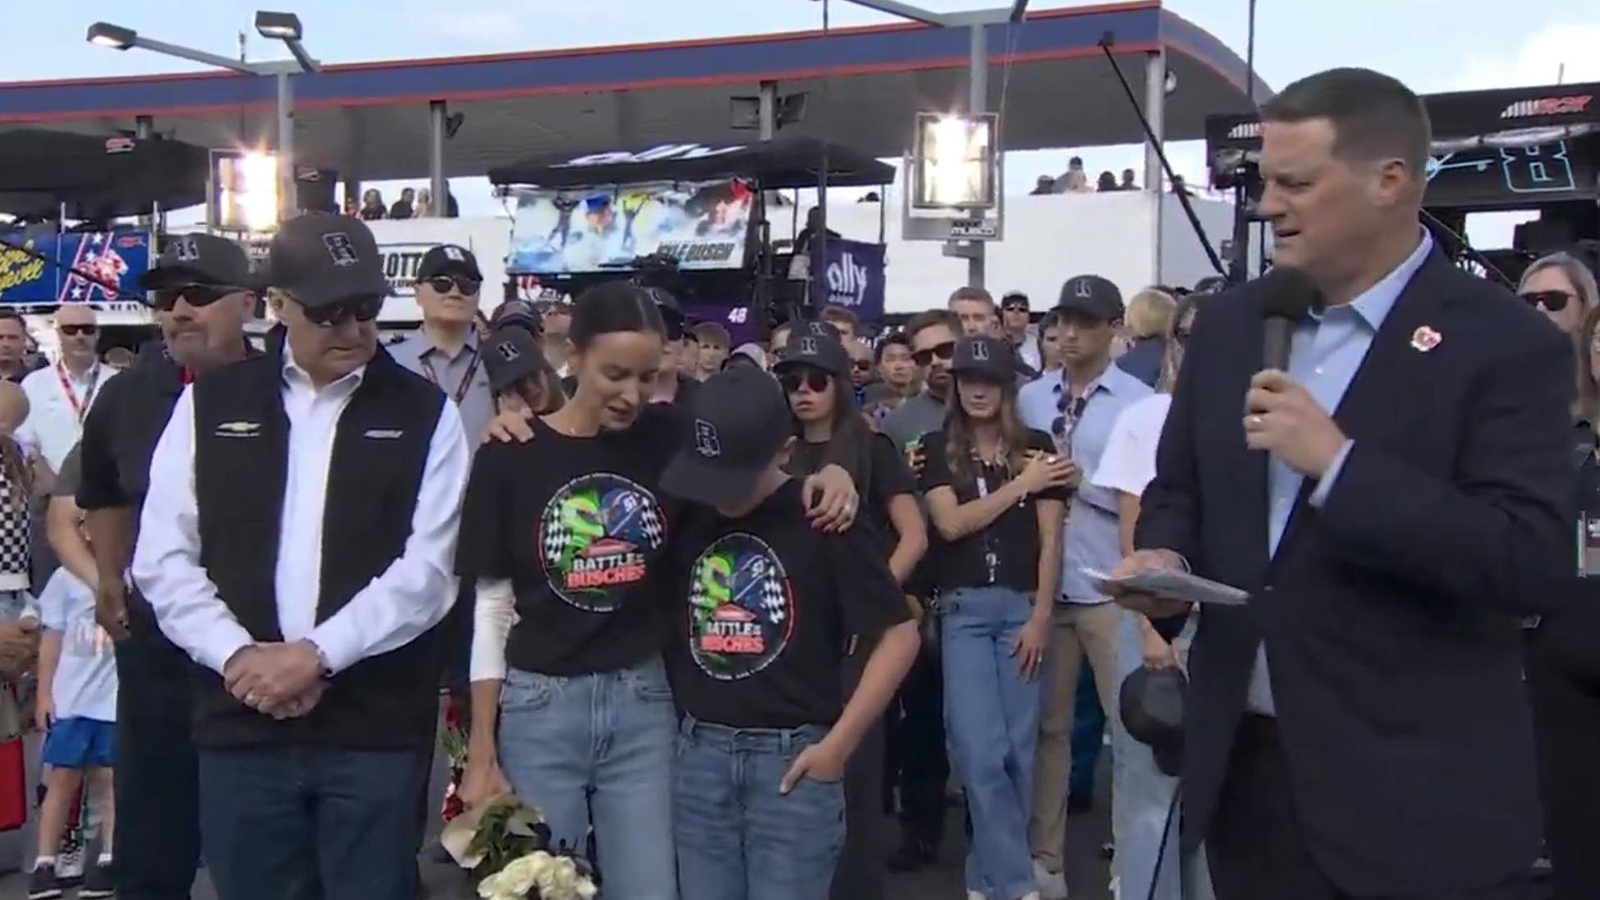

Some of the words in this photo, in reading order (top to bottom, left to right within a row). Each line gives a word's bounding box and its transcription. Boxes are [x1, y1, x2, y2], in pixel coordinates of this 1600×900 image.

[827, 252, 867, 305] ally
[728, 307, 748, 323] 48
[574, 553, 636, 571] BATTLE
